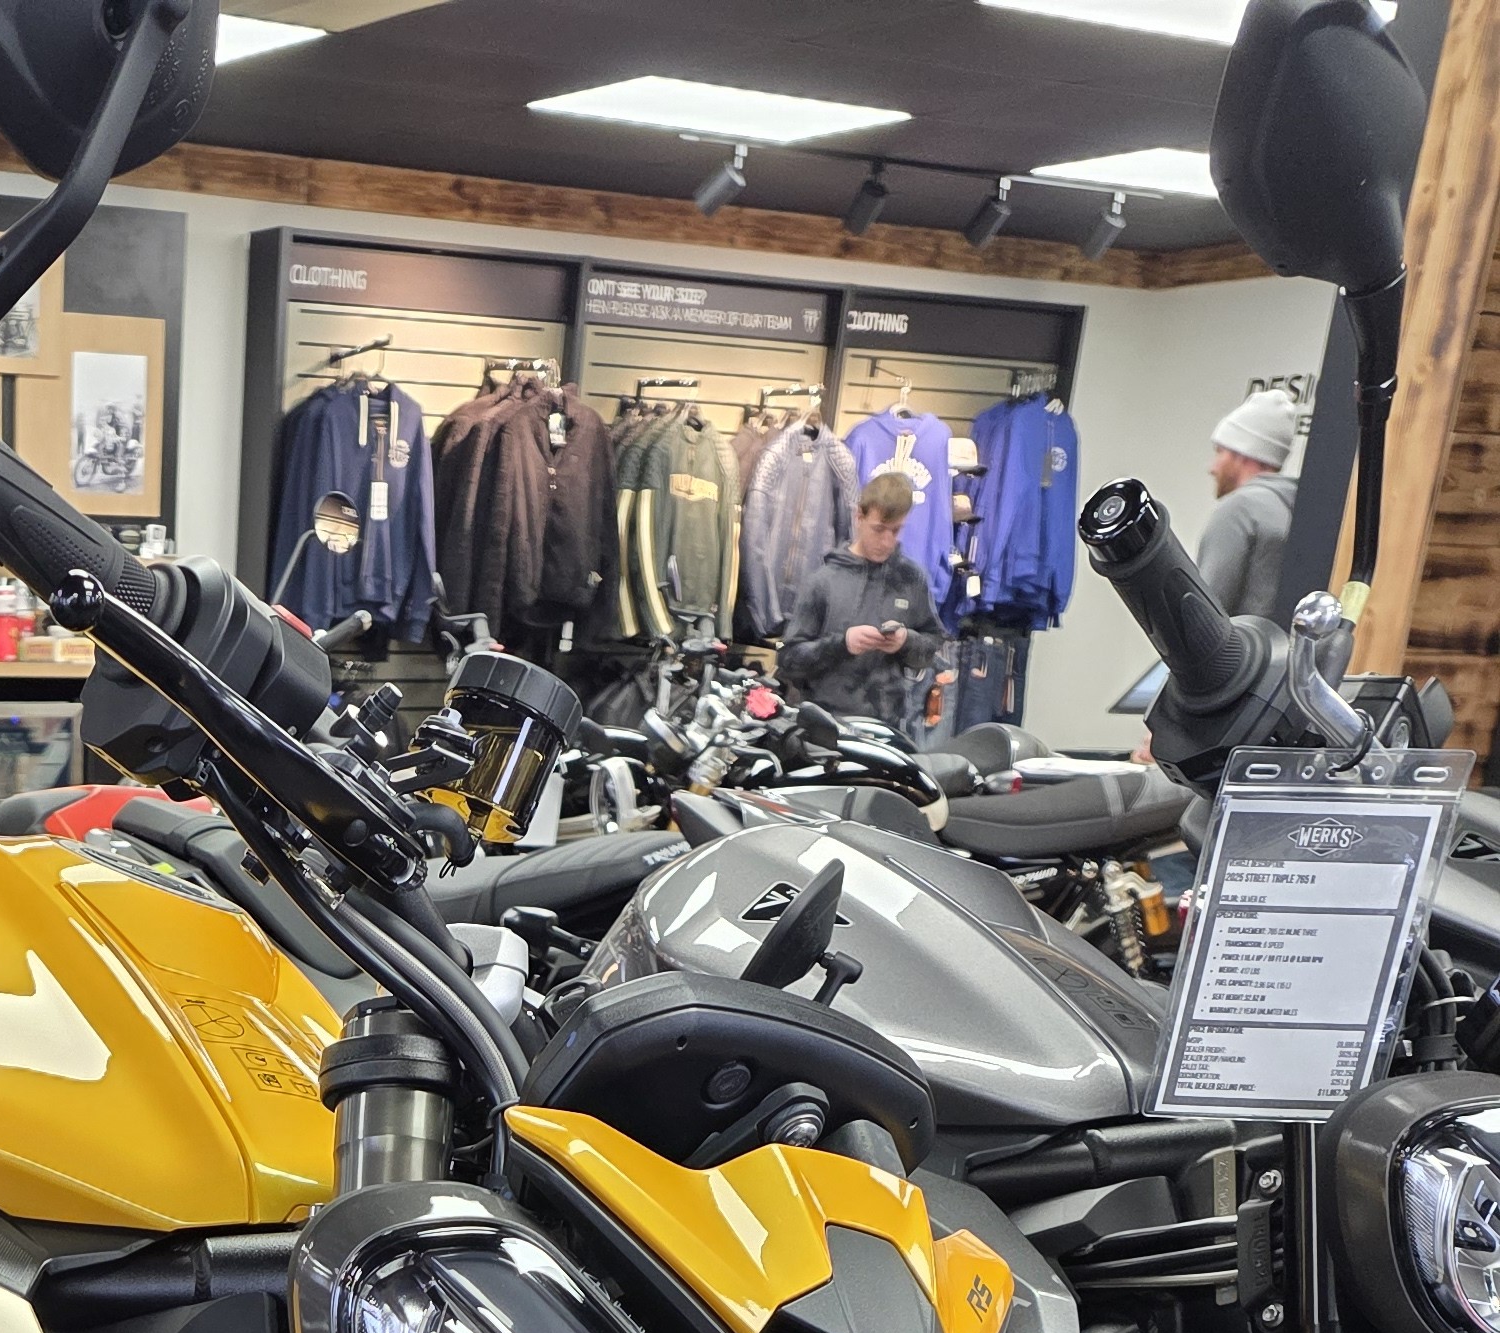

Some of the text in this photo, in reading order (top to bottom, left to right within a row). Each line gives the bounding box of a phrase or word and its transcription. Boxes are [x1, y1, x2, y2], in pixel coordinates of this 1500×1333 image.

[289, 264, 368, 290] CLOTHING
[1298, 827, 1354, 848] WERKS
[1224, 872, 1244, 881] 2025
[1244, 873, 1270, 882] STREET
[1271, 874, 1295, 883] TRIPLE
[967, 1273, 993, 1324] RS
